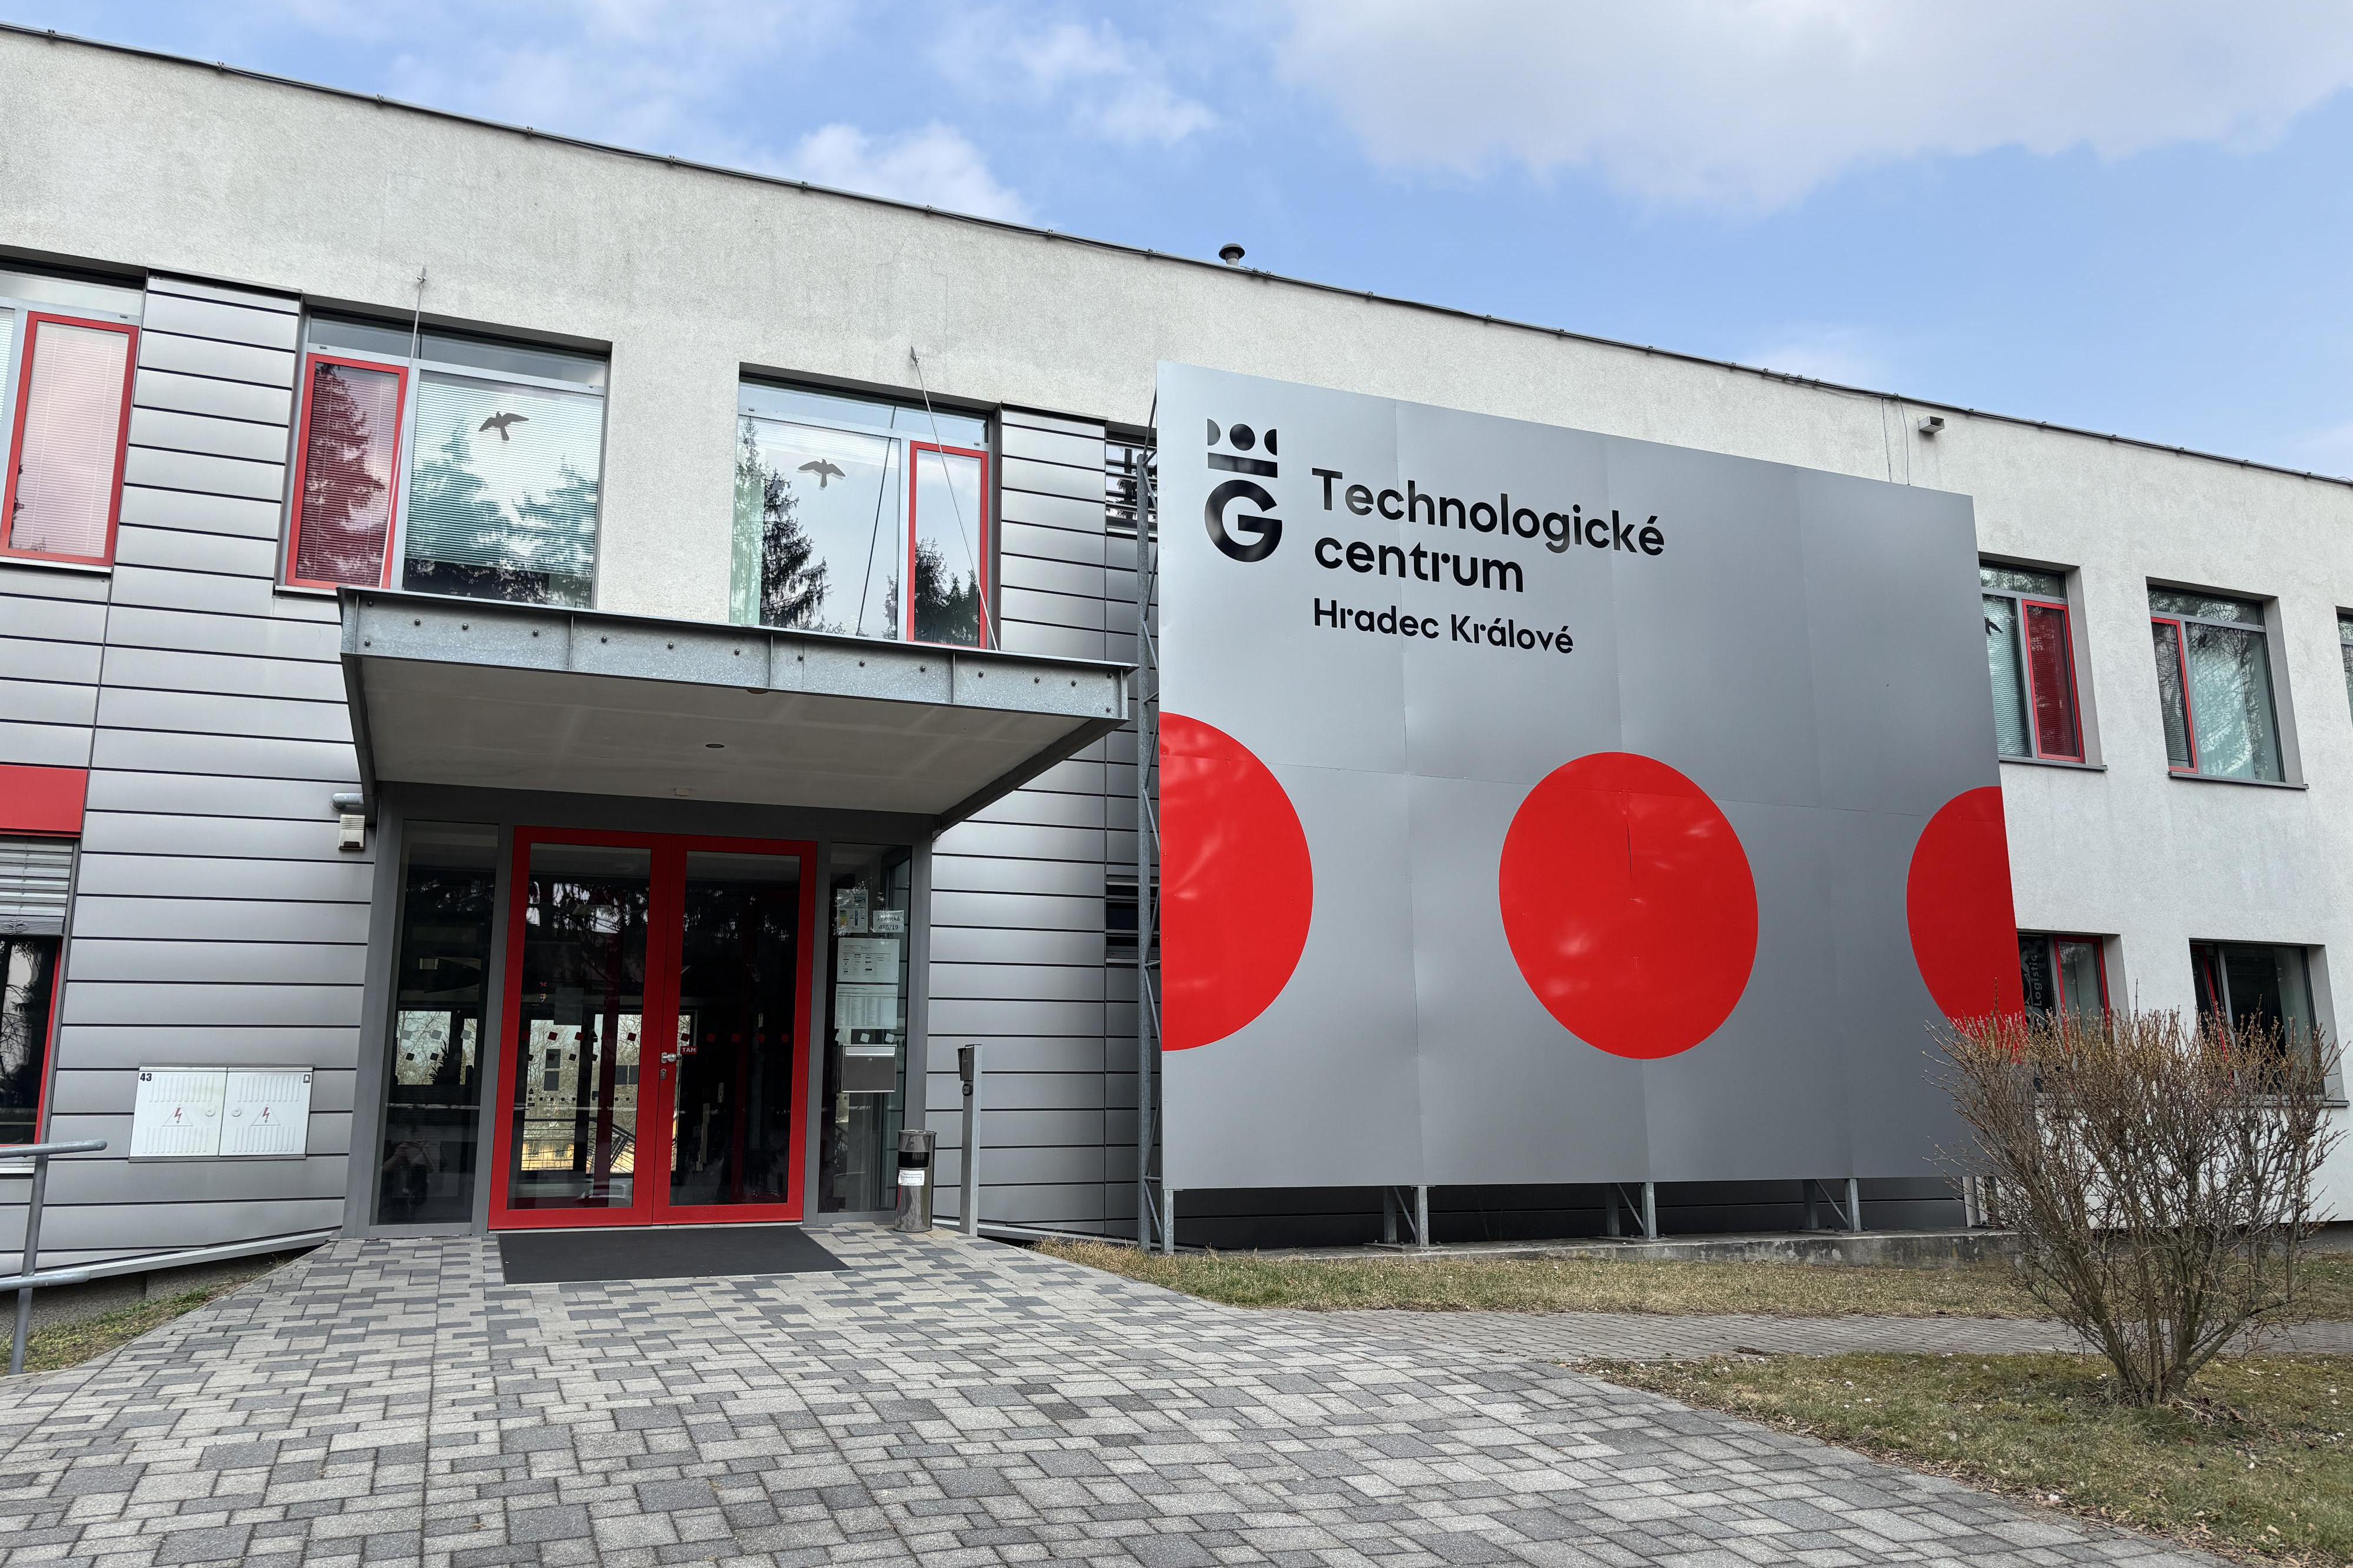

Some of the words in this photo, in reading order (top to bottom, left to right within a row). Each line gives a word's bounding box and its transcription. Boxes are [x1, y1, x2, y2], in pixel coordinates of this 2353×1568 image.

[1312, 468, 1665, 556] Technologické
[1314, 537, 1524, 593] centrum
[1314, 598, 1440, 639] Hradec
[1451, 613, 1574, 654] Králové
[140, 1073, 152, 1082] 43
